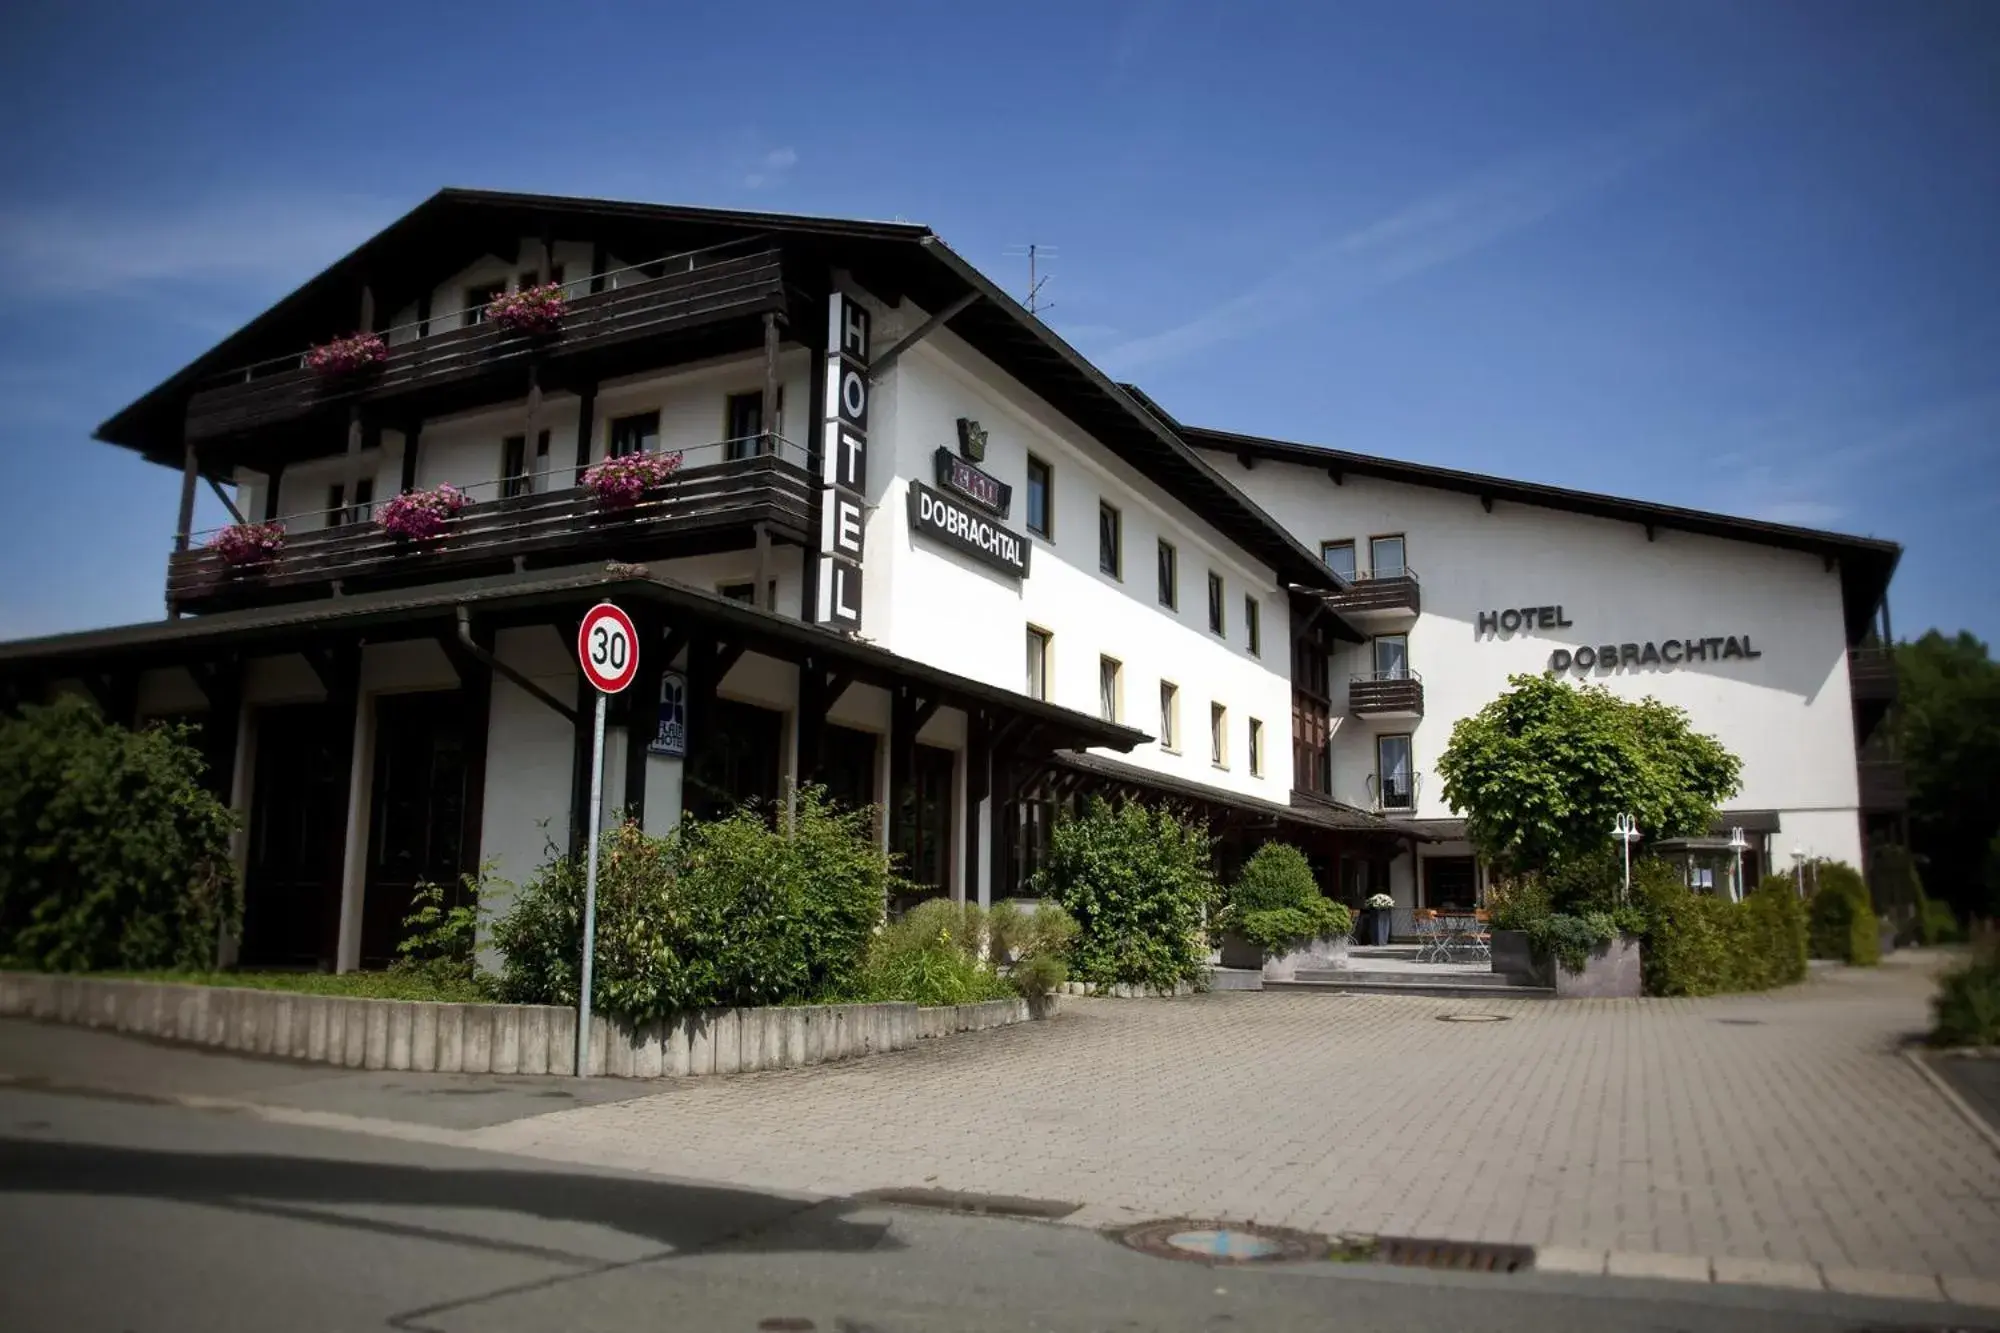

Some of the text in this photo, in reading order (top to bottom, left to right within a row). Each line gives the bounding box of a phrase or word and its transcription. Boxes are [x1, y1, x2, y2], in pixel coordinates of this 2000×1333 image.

[837, 303, 865, 621] HOTEL
[920, 491, 1024, 568] DOBRACHTAL
[1478, 605, 1573, 634] HOTEL
[592, 626, 626, 670] 30
[1551, 635, 1762, 672] DOBRACHTAL
